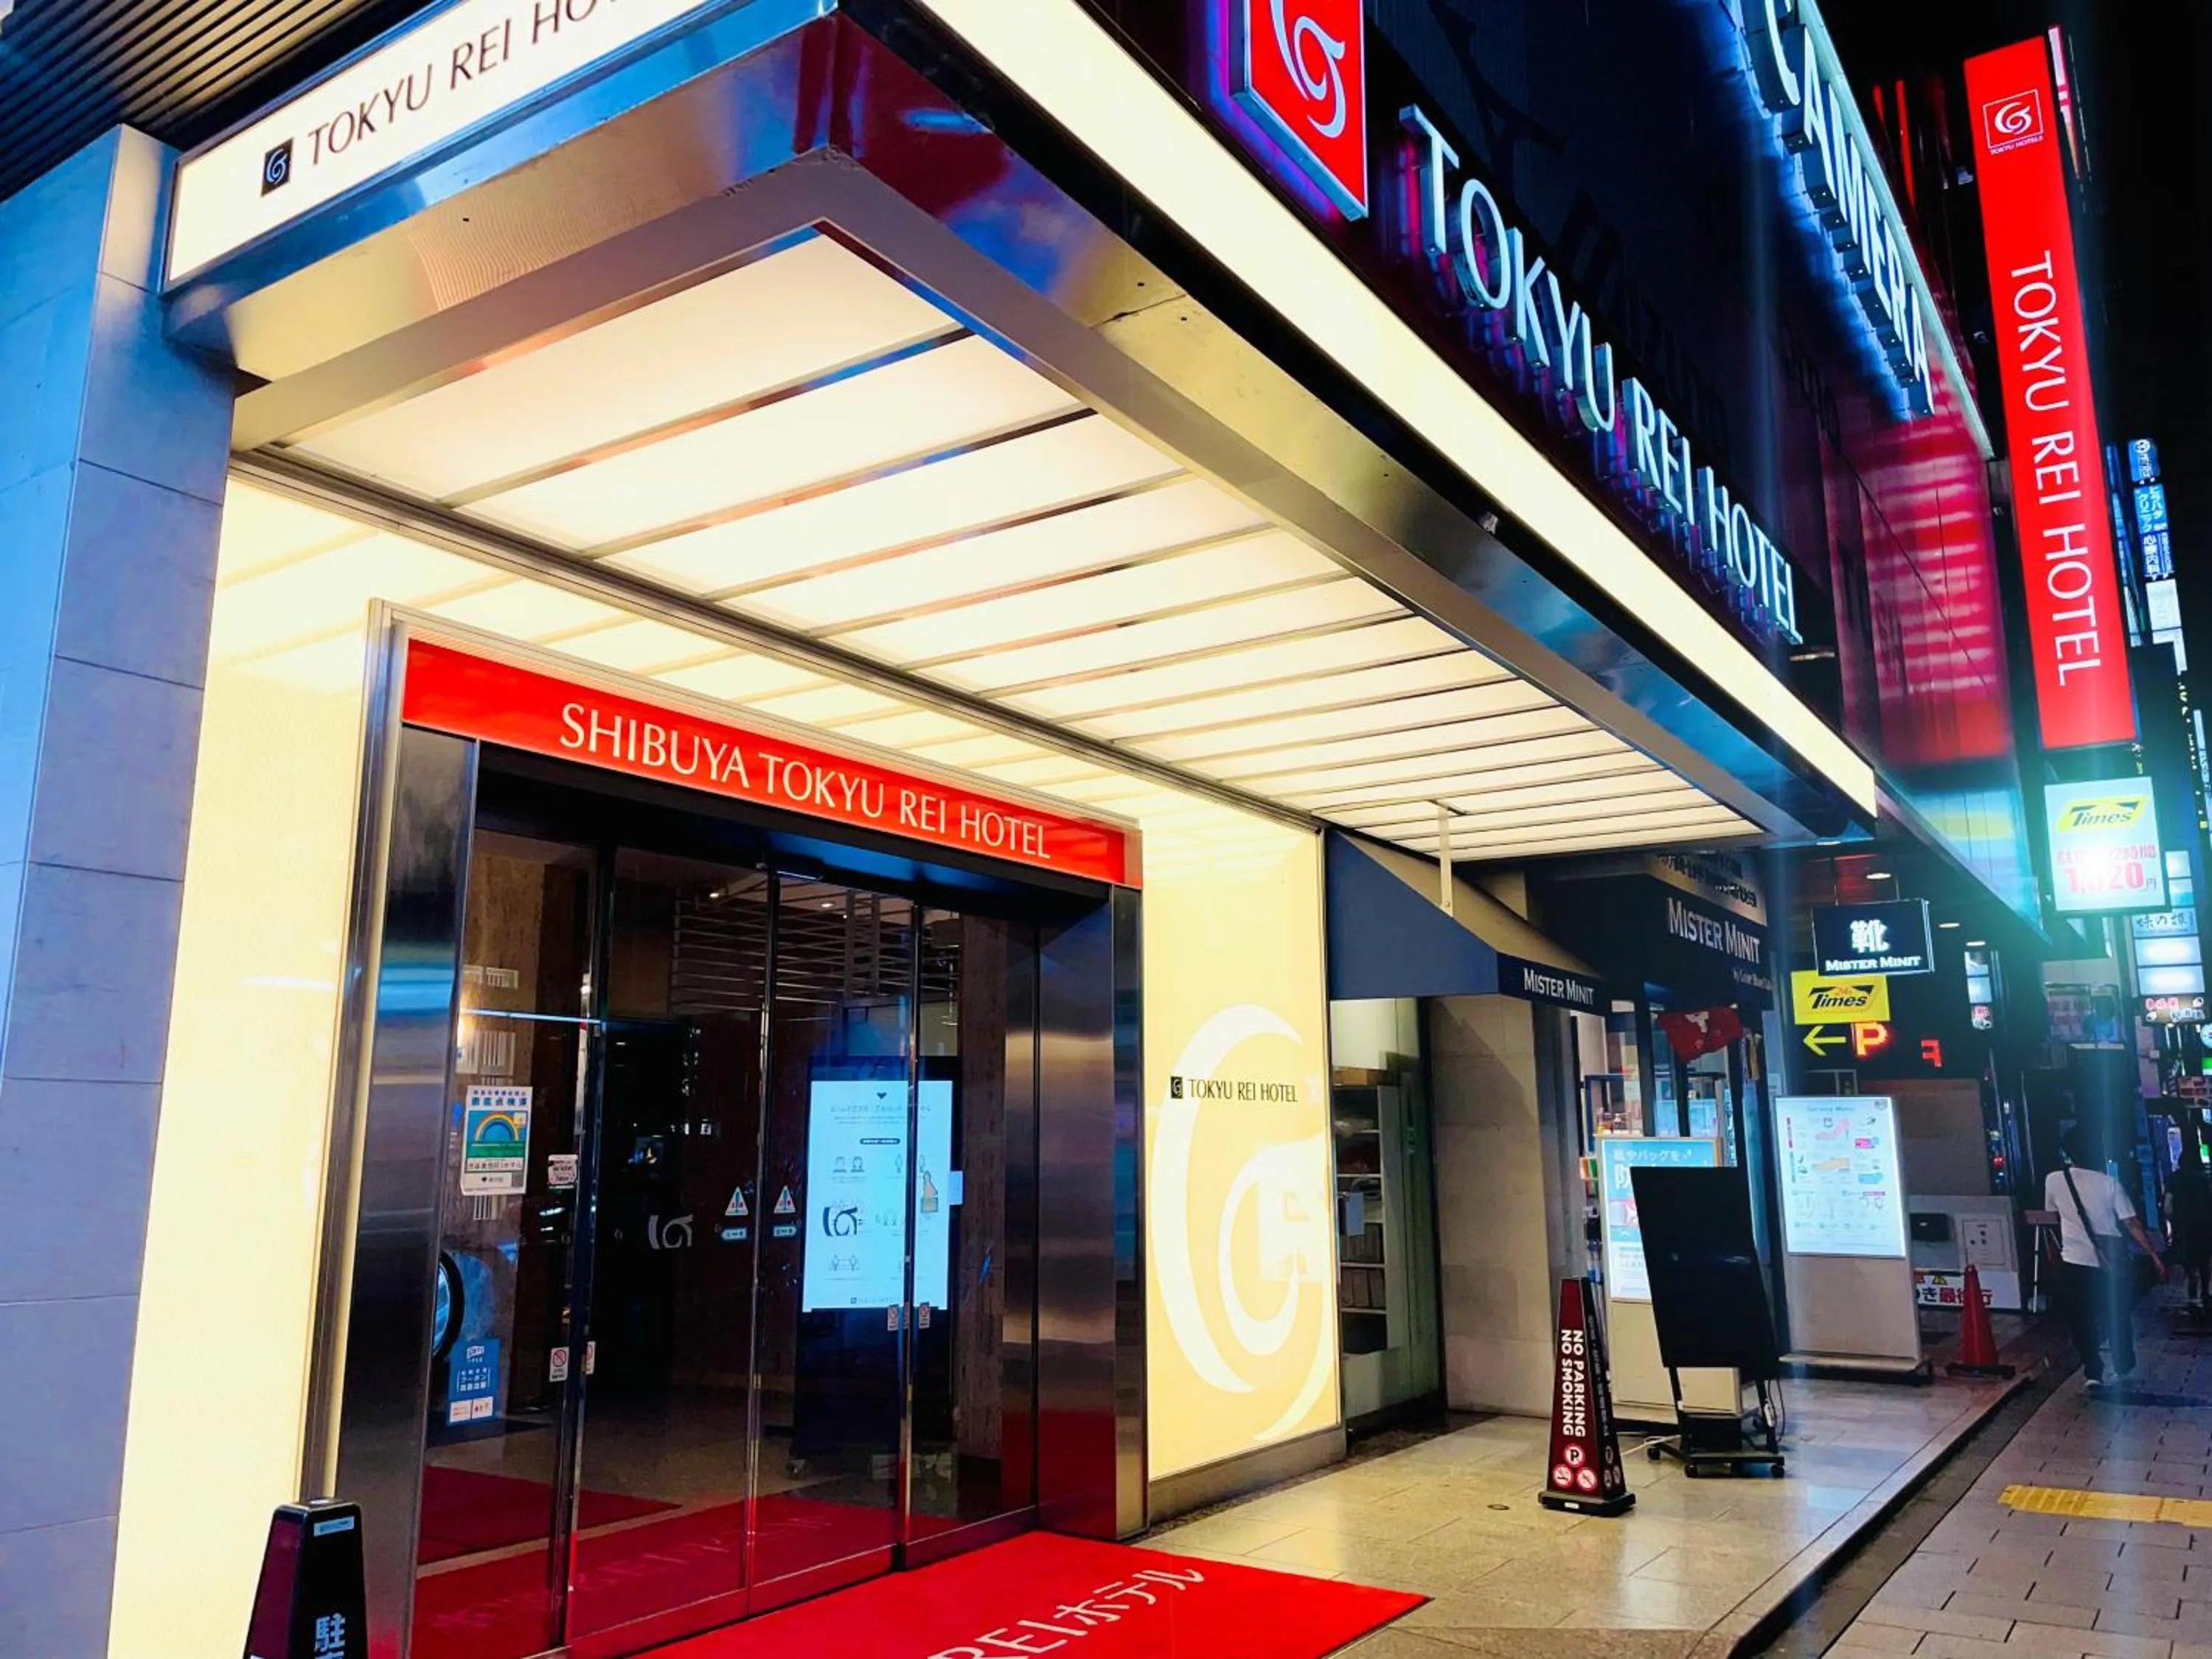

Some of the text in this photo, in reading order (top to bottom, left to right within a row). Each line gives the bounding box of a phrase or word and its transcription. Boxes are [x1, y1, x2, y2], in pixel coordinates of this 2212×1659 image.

[307, 63, 433, 166] TOKYU
[448, 19, 511, 91] REI
[1402, 105, 1804, 645] TOKYU REI HOTEL
[2011, 249, 2101, 686] TOKYU REI HOTEL
[559, 703, 1051, 859] SHIBUYA TOKYU REI HOTEL
[1668, 896, 1761, 964] MISTER MINIT
[1825, 956, 1921, 972] MISTER MINIT
[1850, 919, 1891, 953] 靴
[1523, 967, 1594, 1006] MISTER MINIT
[1809, 988, 1870, 1009] Times
[1852, 1021, 1888, 1057] P
[1188, 1079, 1298, 1102] TOKYU REI HOTEL
[1561, 1329, 1574, 1436] NO SMOKING
[1573, 1329, 1586, 1438] NO PARKING
